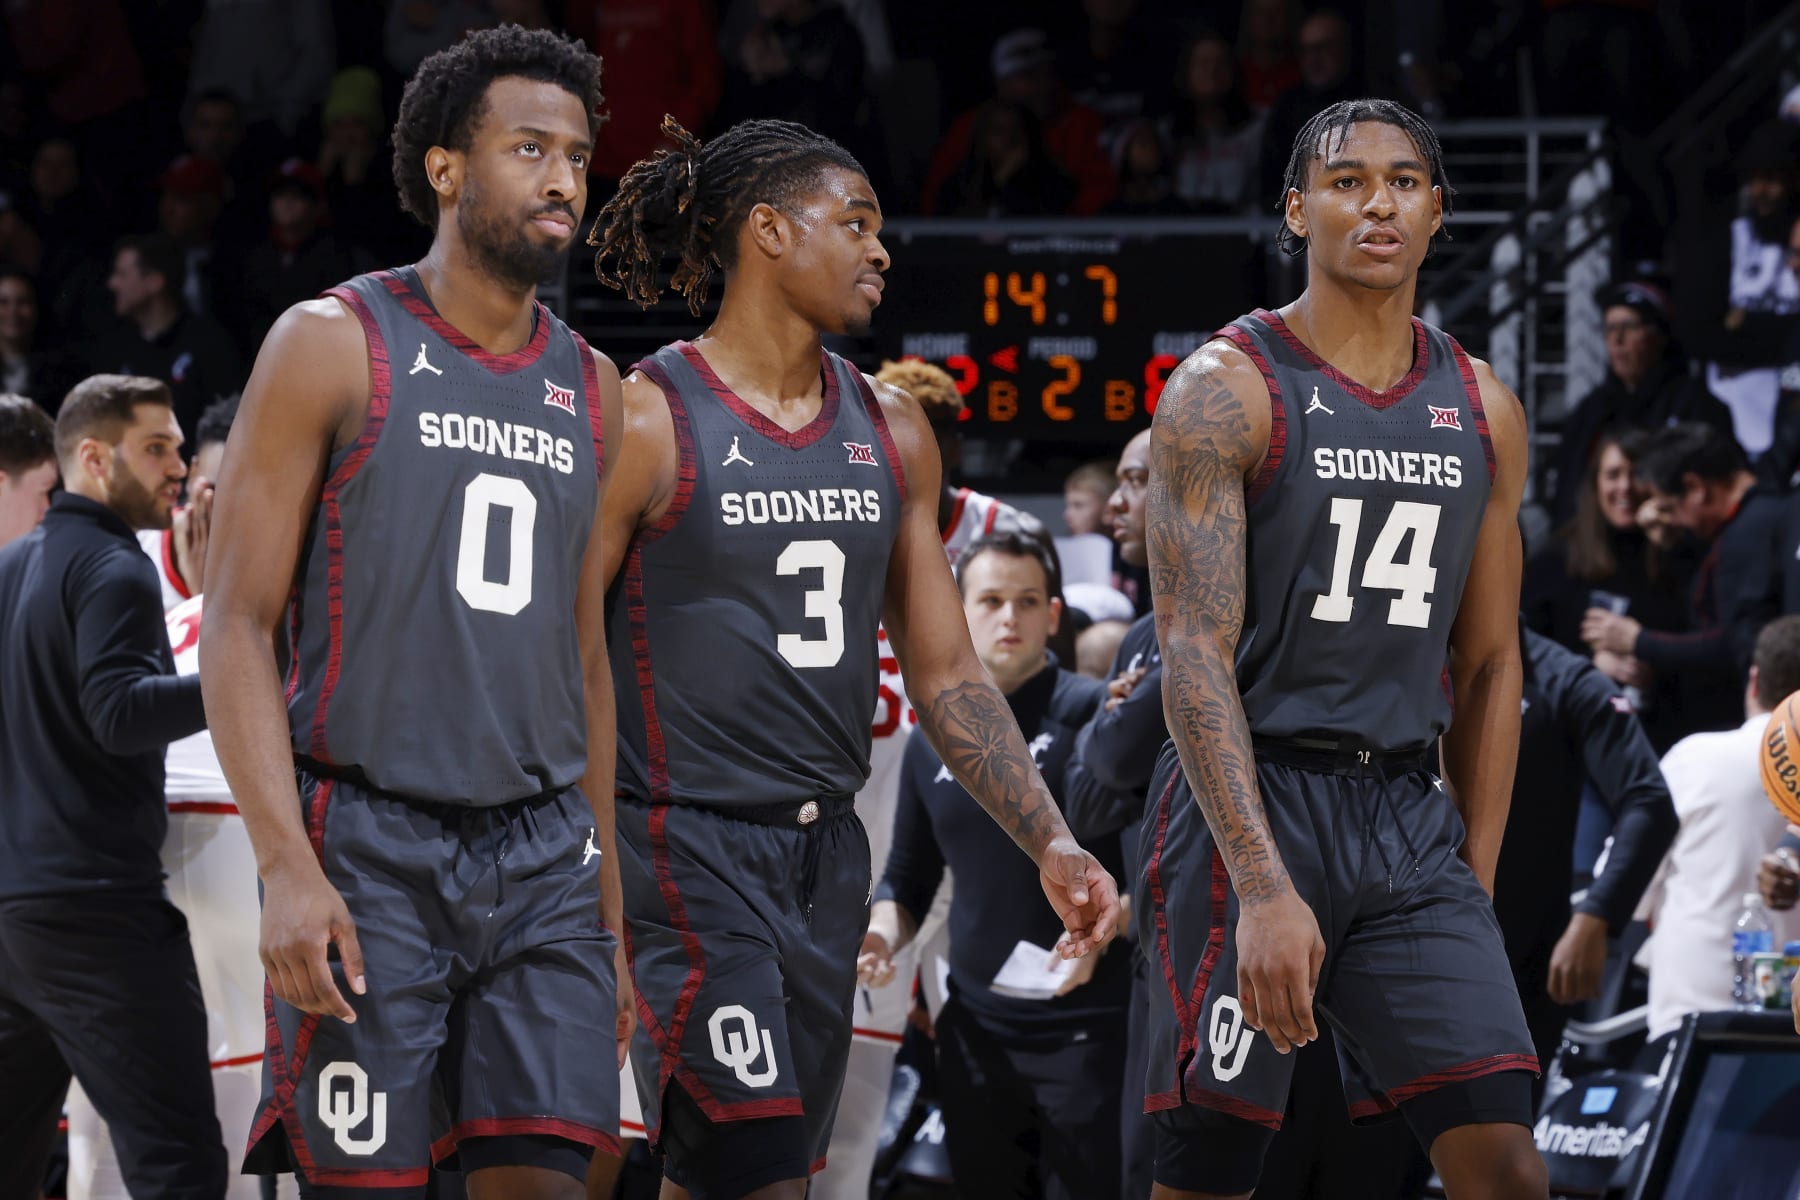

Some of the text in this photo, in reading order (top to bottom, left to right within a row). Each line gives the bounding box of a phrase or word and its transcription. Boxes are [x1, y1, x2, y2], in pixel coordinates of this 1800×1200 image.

[1027, 337, 1098, 360] PERIOD
[987, 379, 1019, 422] B
[1041, 355, 1082, 421] 2
[1104, 379, 1136, 422] B
[418, 411, 575, 475] SOONERS
[1314, 447, 1463, 488] SOONERS
[720, 488, 881, 526] SOONERS
[456, 473, 537, 615] 0
[1310, 497, 1442, 628] 14
[776, 539, 846, 668] 3
[707, 1004, 778, 1088] OU
[1208, 995, 1255, 1082] OU
[318, 1061, 387, 1156] OU
[1533, 1114, 1628, 1158] Ameritas
